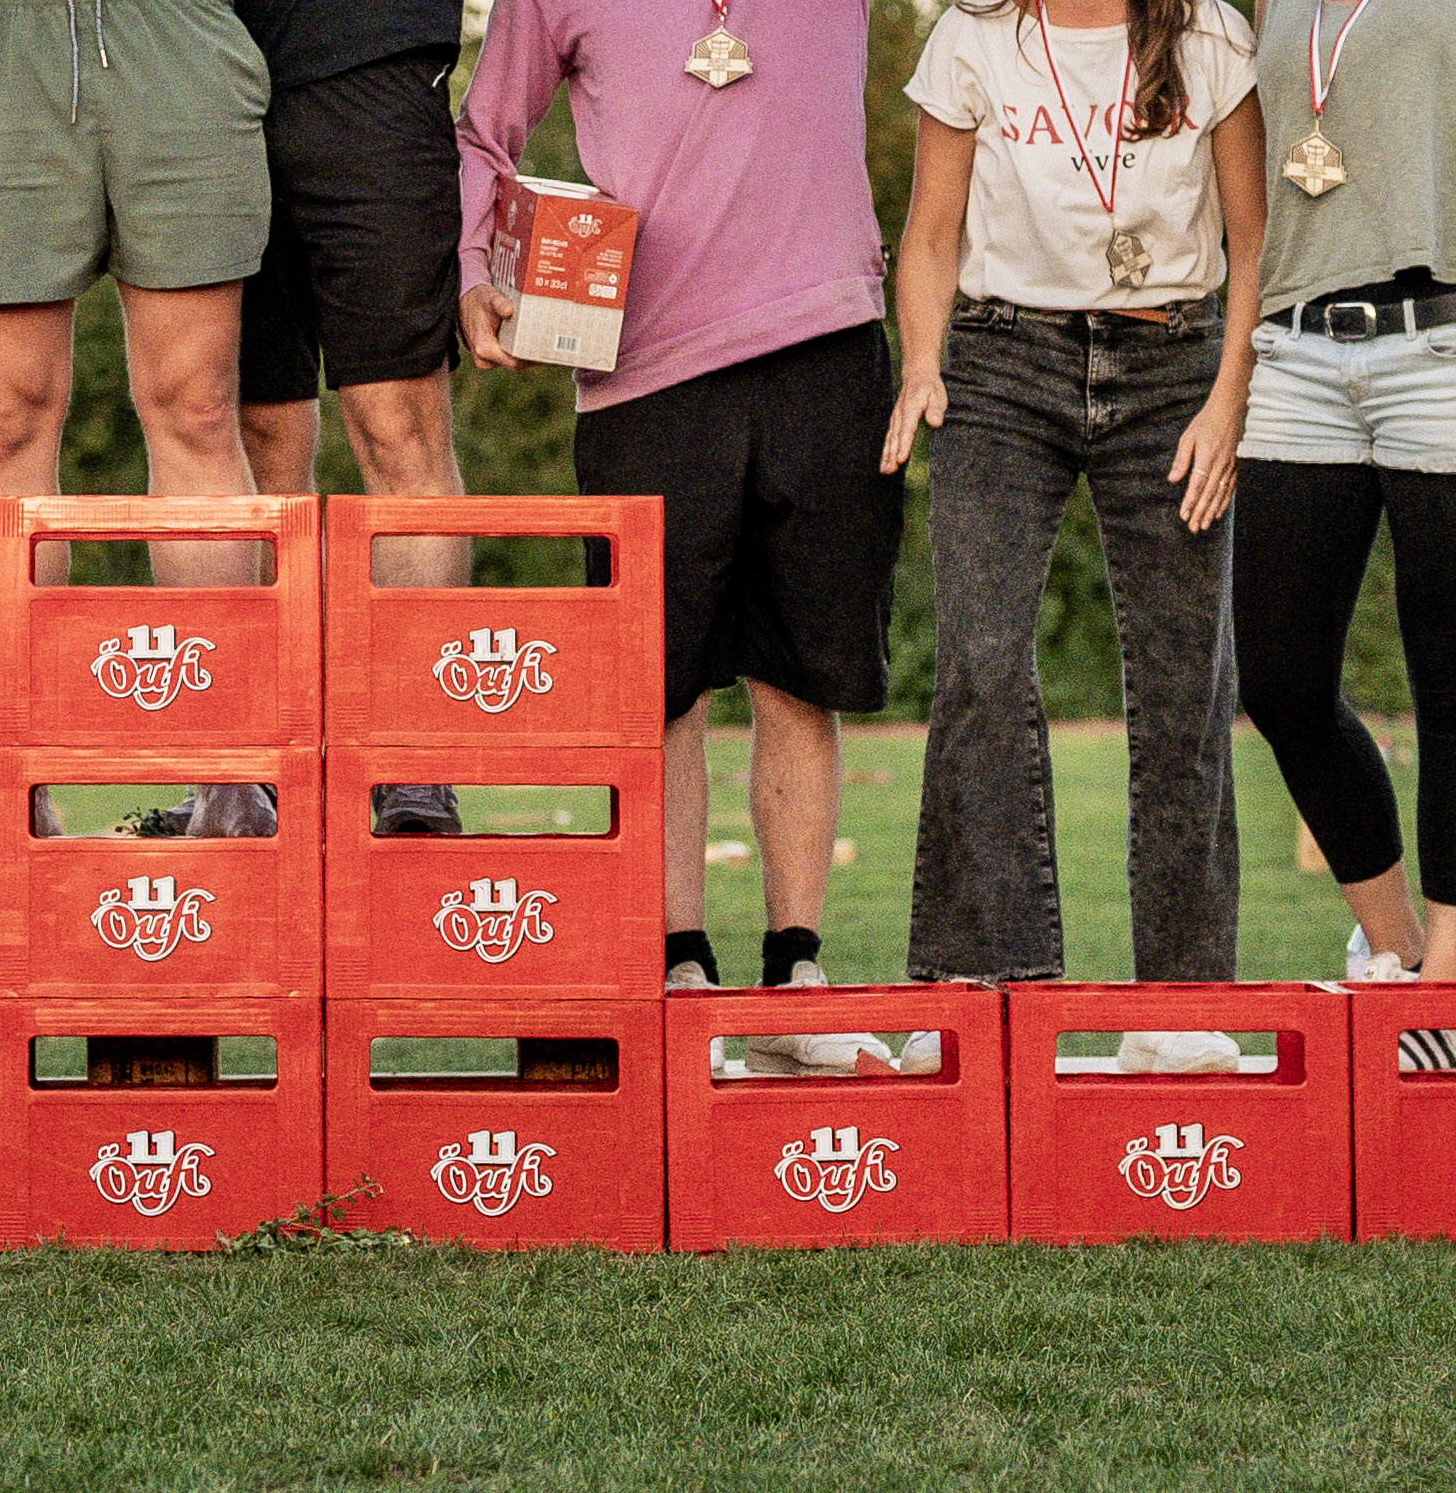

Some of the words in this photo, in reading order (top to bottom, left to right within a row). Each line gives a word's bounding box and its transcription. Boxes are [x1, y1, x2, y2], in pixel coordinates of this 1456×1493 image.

[1071, 150, 1136, 172] vve
[127, 624, 176, 659] 11
[469, 627, 518, 662] 11
[127, 875, 176, 910] 11
[469, 877, 518, 912] 11
[125, 1130, 174, 1165] 11
[467, 1130, 516, 1165] 11
[810, 1125, 859, 1160] 11
[1154, 1123, 1203, 1158] 11
